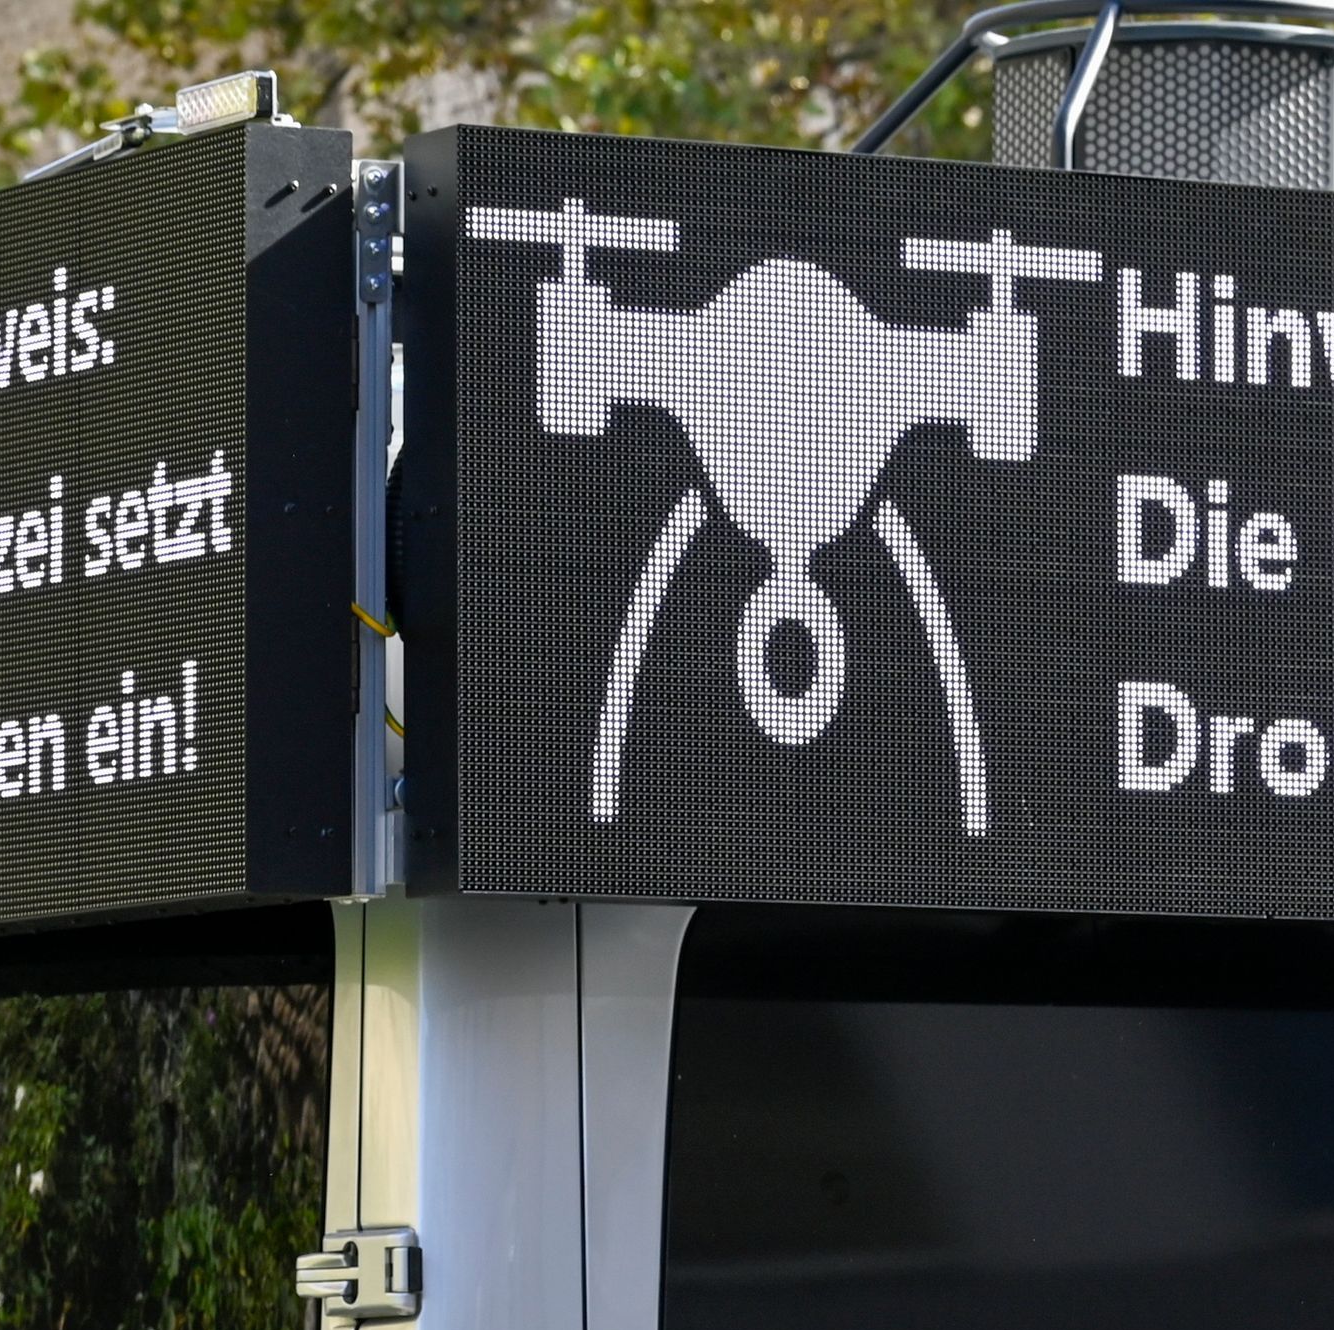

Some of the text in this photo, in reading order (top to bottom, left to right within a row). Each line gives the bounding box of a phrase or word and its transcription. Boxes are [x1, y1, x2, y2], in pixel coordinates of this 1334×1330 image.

[85, 450, 231, 577] setzt
[1117, 474, 1298, 590] Die
[85, 661, 197, 785] ein!
